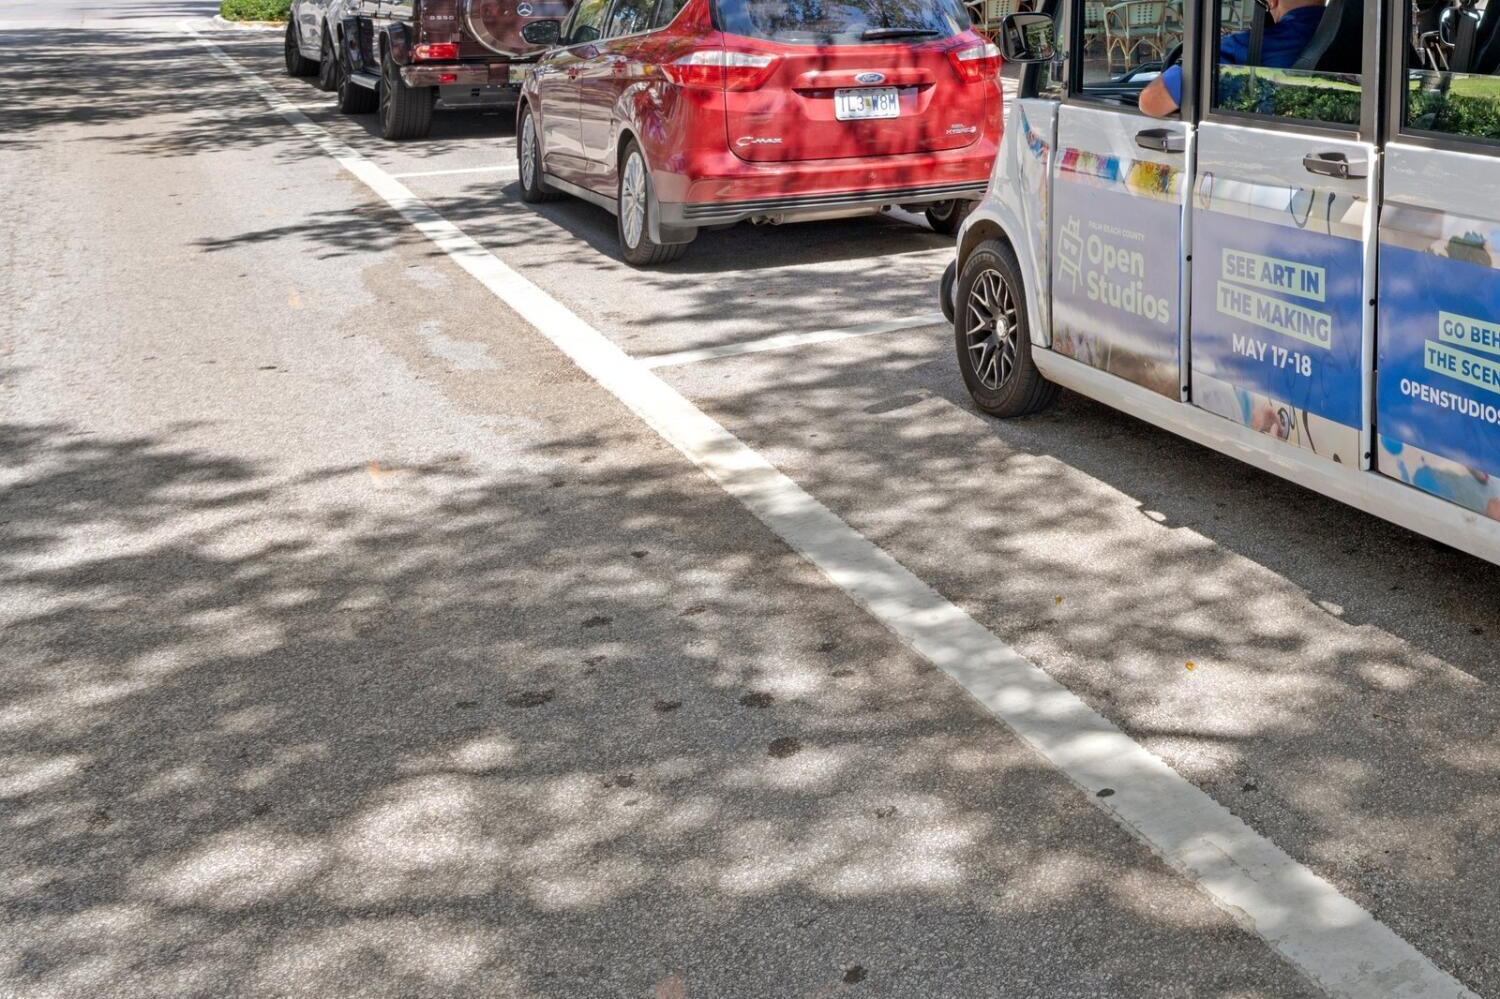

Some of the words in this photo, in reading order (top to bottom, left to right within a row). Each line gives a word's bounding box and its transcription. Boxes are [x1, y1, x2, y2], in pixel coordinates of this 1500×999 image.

[1087, 234, 1145, 279] Open
[1226, 254, 1256, 280] SEE
[1260, 261, 1296, 288] ART
[1300, 269, 1320, 294] IN
[1087, 270, 1170, 324] Studios
[1221, 287, 1252, 316] THE
[1256, 298, 1329, 342] MAKING
[1443, 319, 1466, 339] GO
[1232, 333, 1267, 362] MAY
[1271, 344, 1312, 377] 17-18
[1427, 347, 1457, 372] THE
